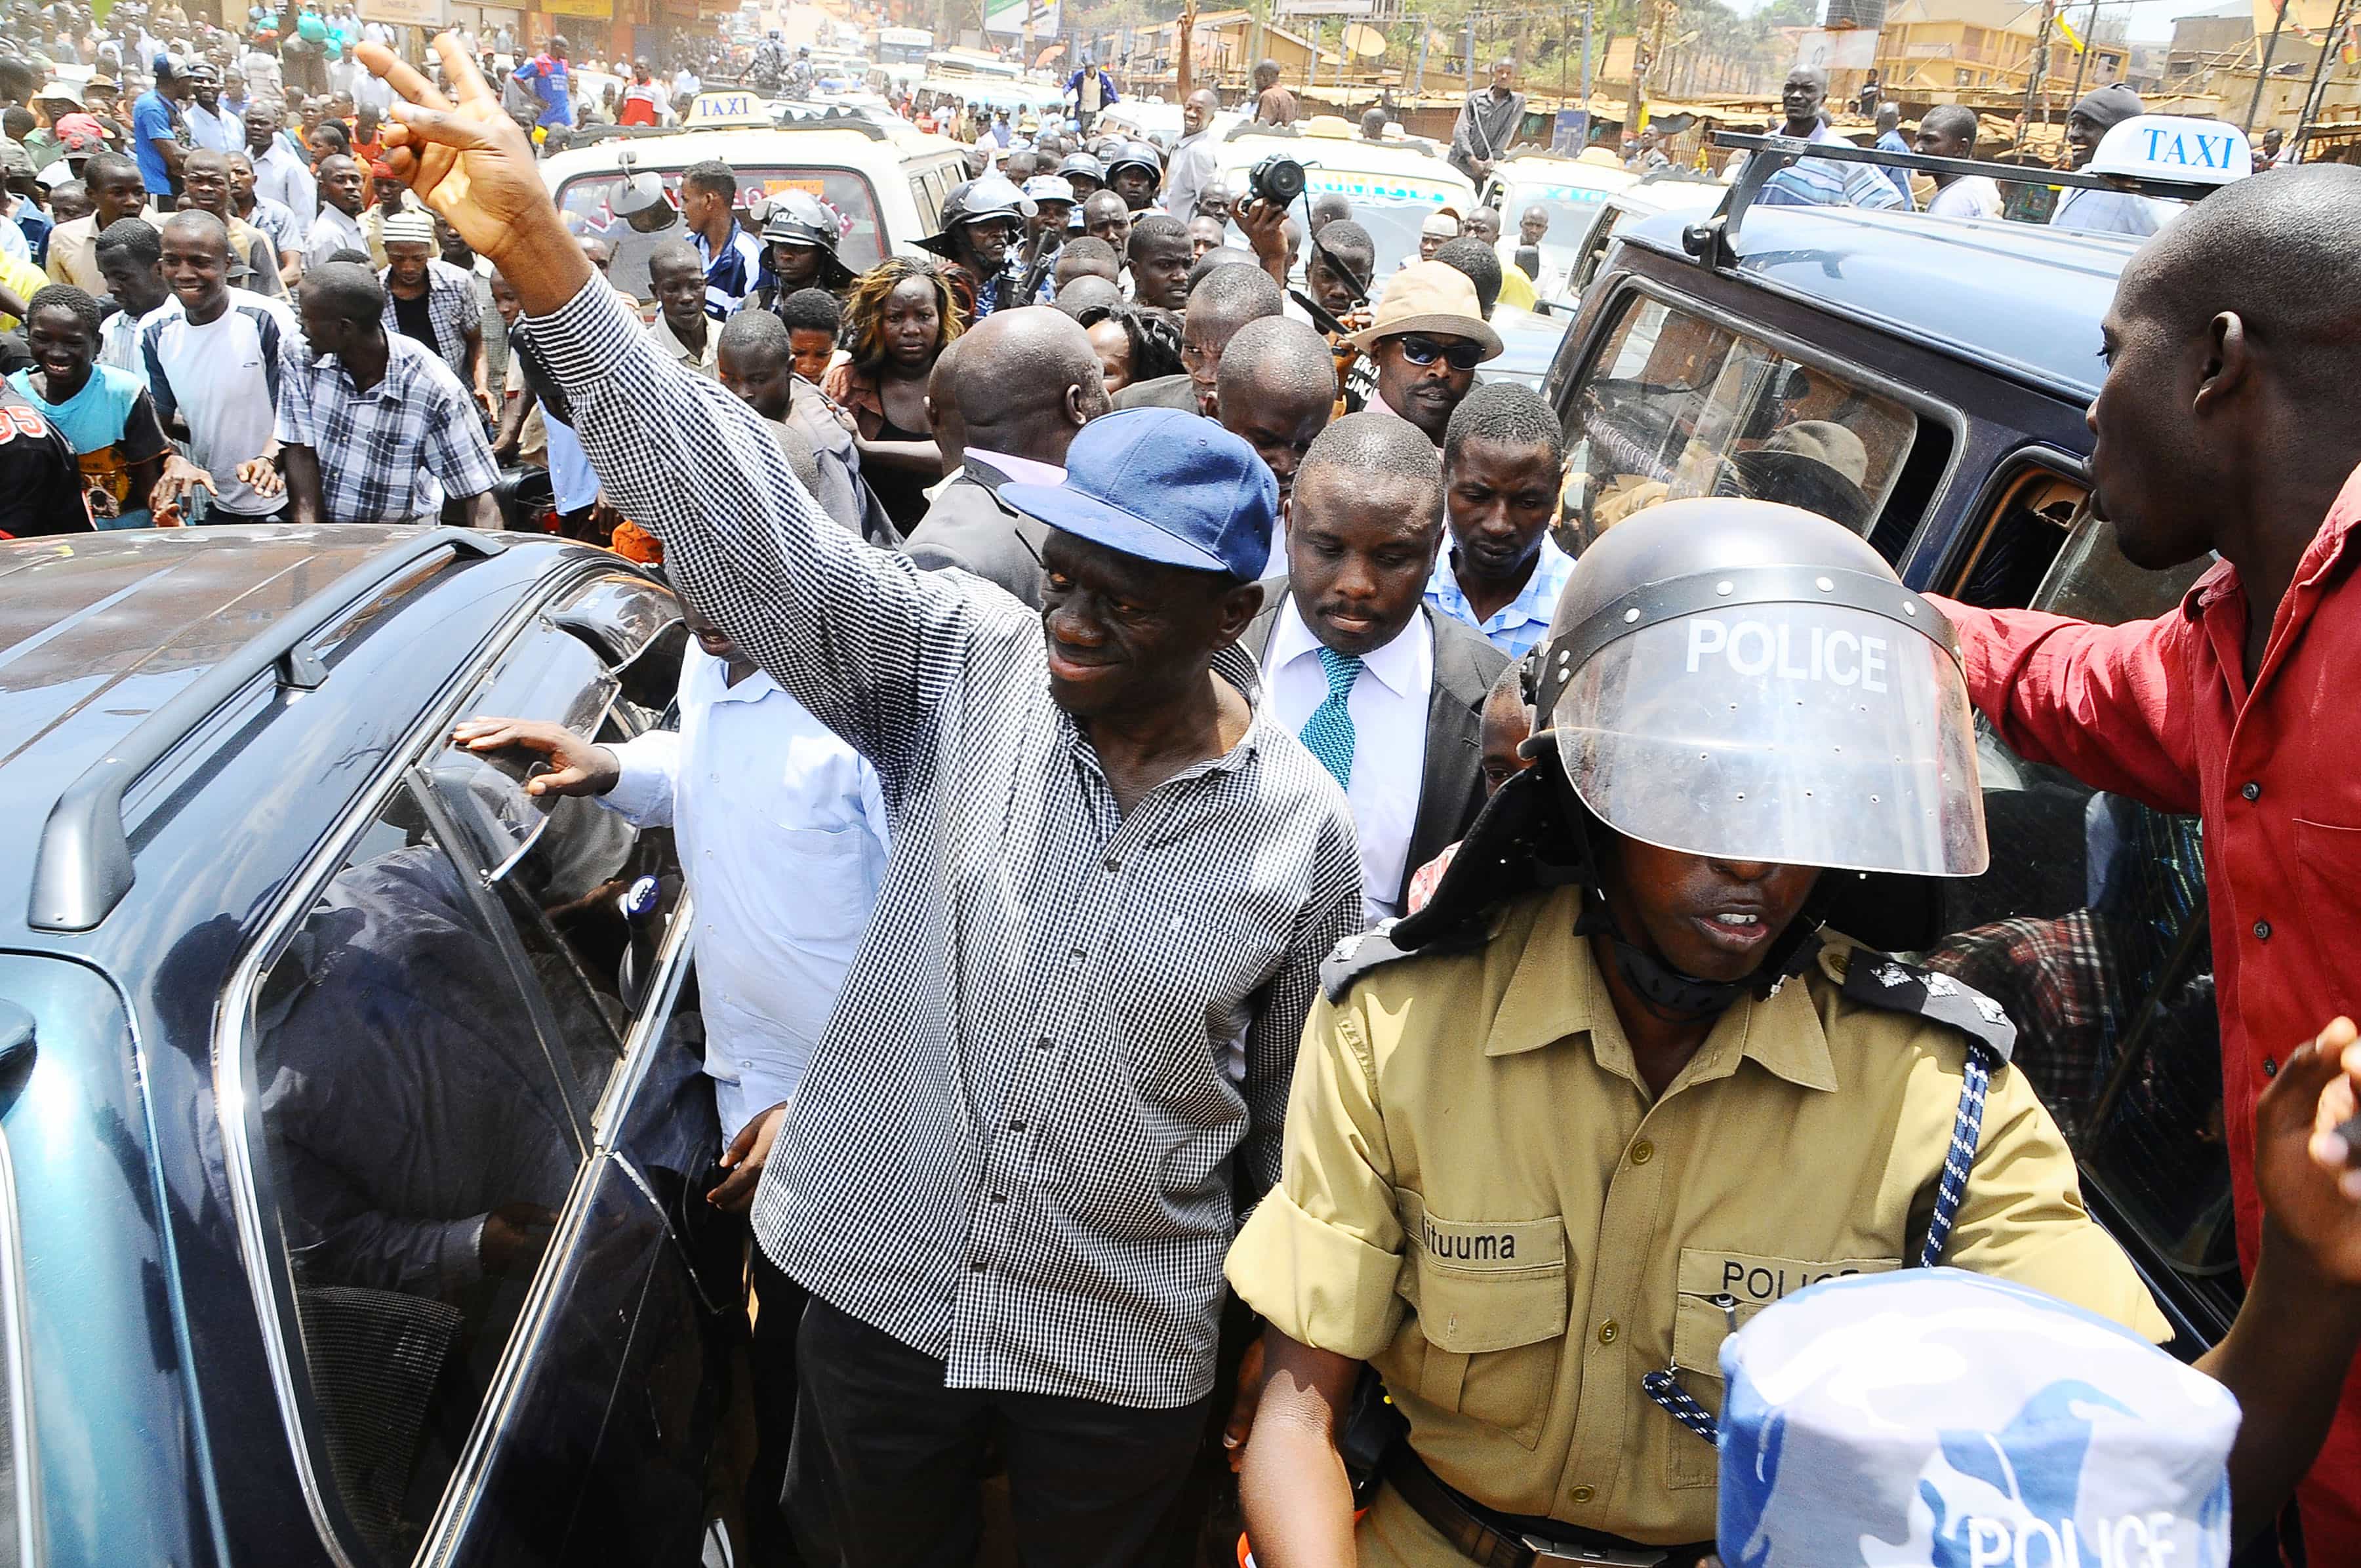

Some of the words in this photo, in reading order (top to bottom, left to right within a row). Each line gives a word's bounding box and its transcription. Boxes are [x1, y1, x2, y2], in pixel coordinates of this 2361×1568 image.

[697, 97, 749, 117] TAXI
[2143, 129, 2235, 169] TAXI
[1685, 618, 1888, 694] POLICE
